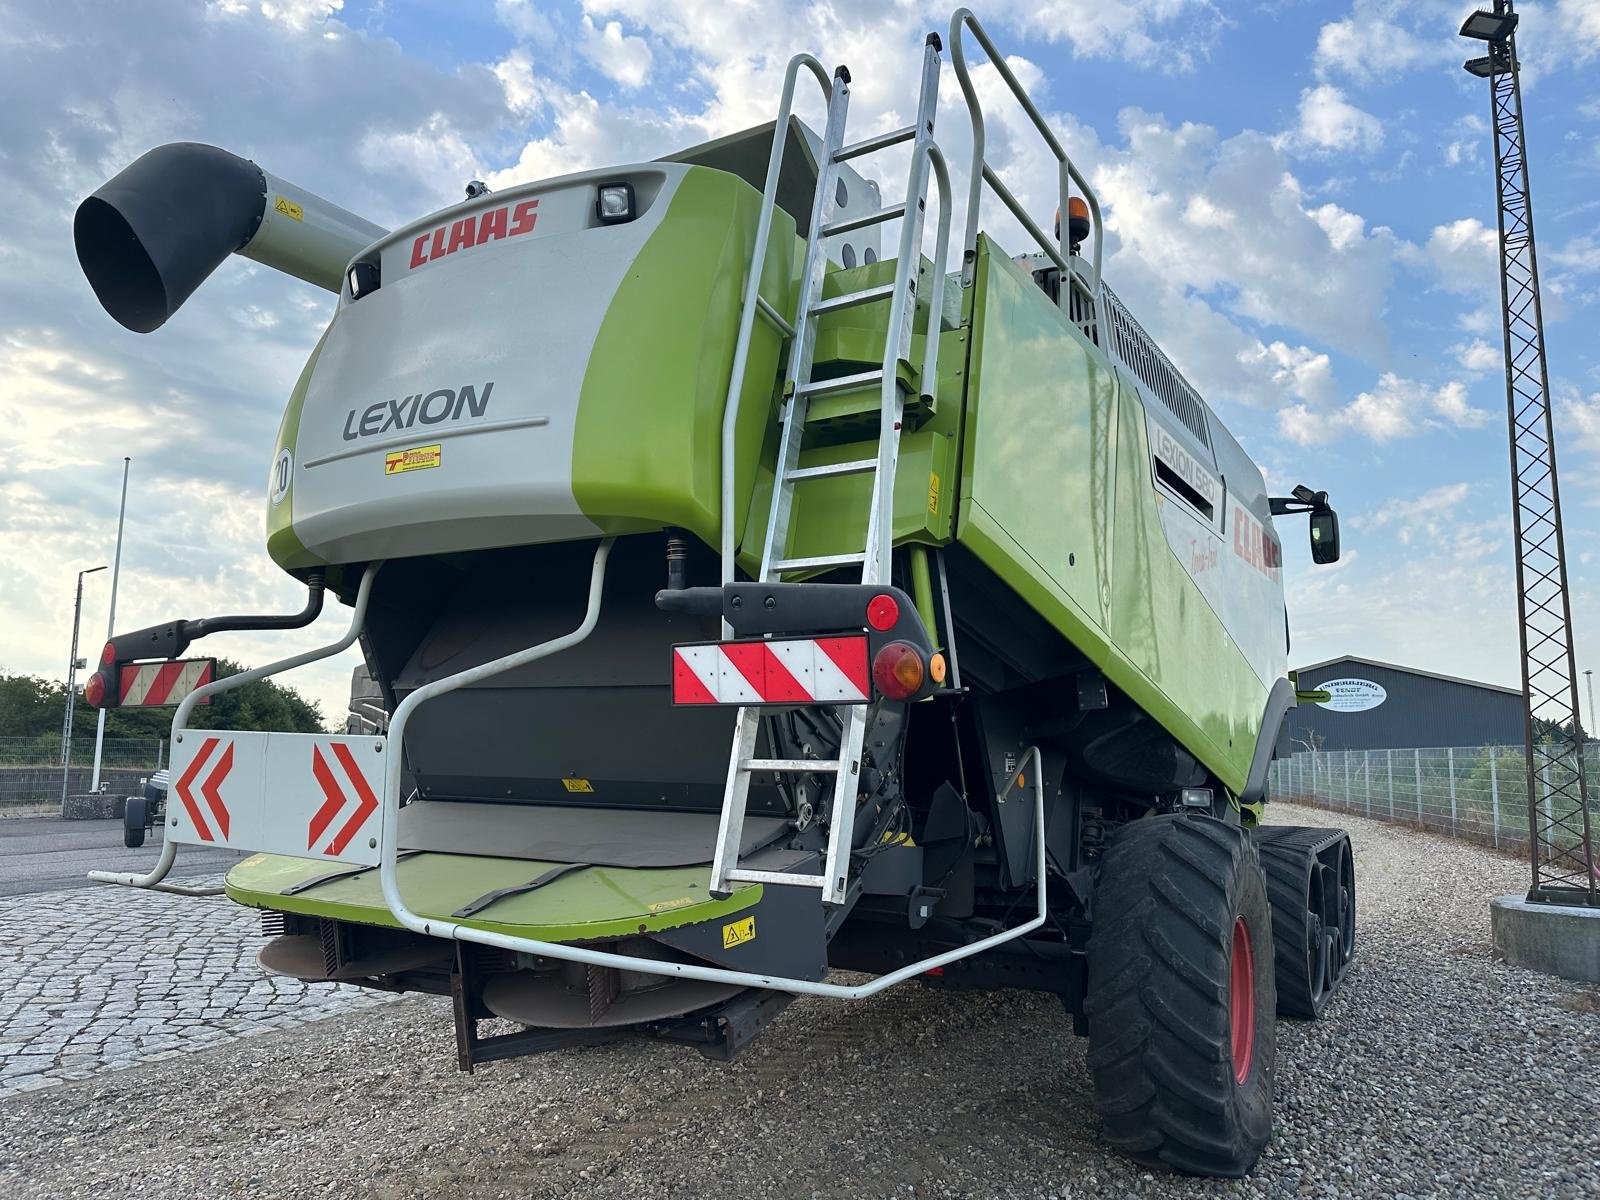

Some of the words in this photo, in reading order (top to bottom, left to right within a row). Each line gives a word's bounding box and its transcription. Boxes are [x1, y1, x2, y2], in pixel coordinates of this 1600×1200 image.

[409, 200, 539, 269] CLAAS
[343, 382, 494, 441] LEXION
[1156, 428, 1194, 483] LEXION
